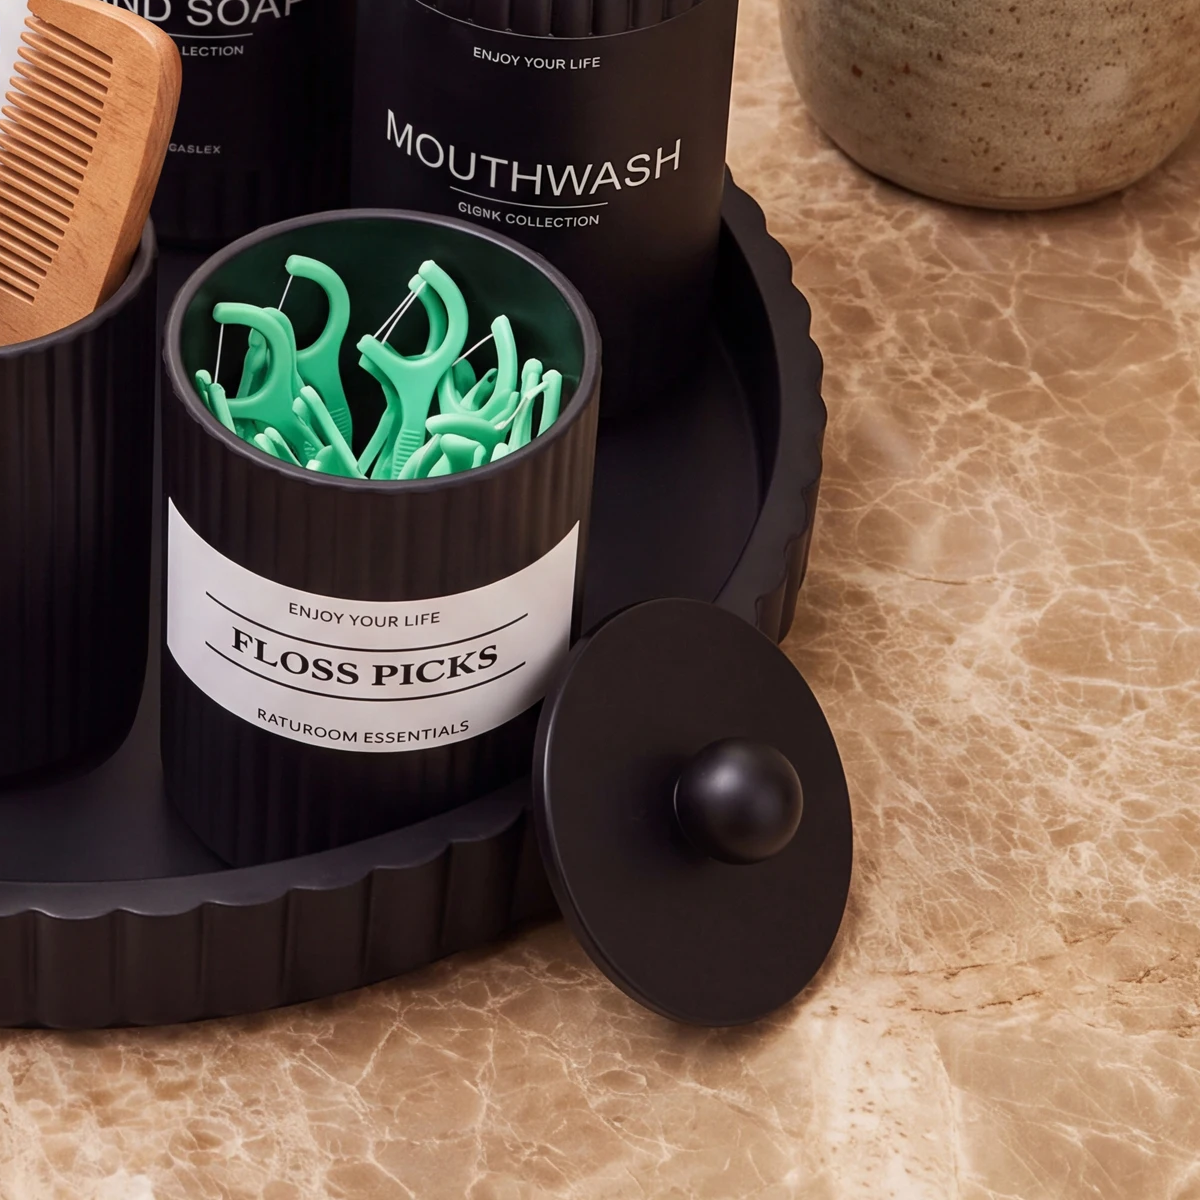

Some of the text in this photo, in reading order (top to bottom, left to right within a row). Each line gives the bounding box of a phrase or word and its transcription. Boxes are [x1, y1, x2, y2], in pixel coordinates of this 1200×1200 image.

[181, 45, 244, 57] LECTION
[473, 46, 601, 70] ENJOY YOUR LIFE
[386, 108, 682, 197] MOUTHWASH
[505, 213, 600, 228] COLLECTION
[289, 602, 441, 628] ENJOY YOUR LIFE
[231, 626, 499, 687] FLOSS PICKS
[257, 707, 470, 745] RATUROOM ESSENTIALS
